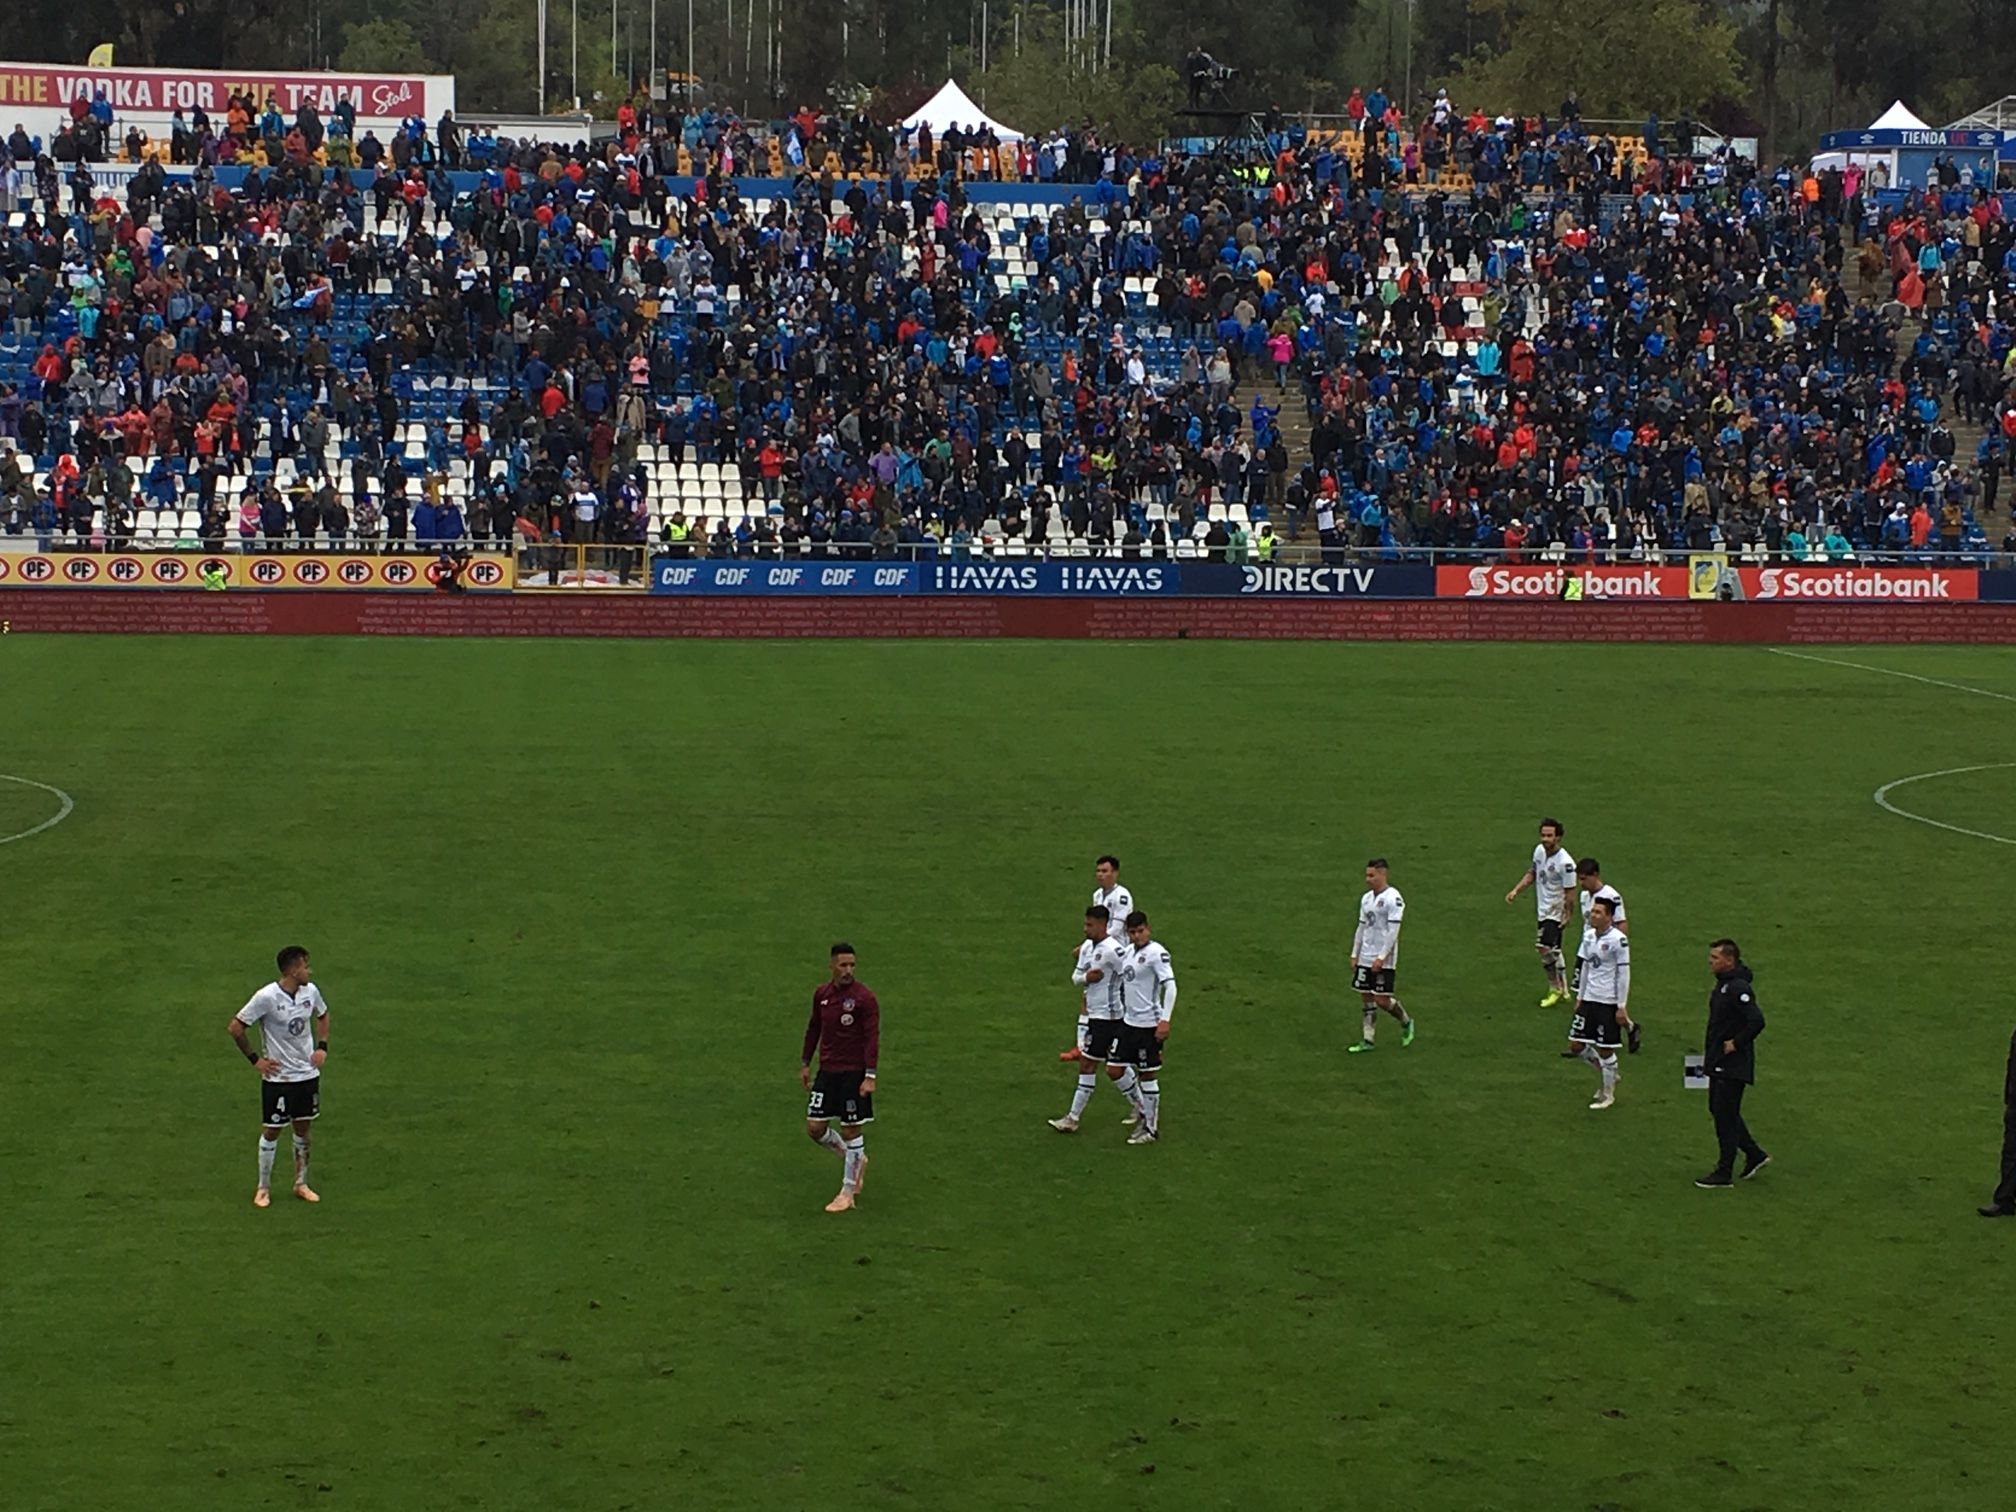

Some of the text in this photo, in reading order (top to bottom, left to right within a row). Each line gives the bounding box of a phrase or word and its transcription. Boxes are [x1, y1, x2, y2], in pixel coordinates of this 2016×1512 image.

[0, 75, 47, 103] THE
[56, 76, 153, 107] VODKA
[162, 80, 214, 109] FOR
[1901, 131, 1947, 145] TIENDA
[27, 561, 46, 577] PF
[71, 562, 91, 578] PF
[115, 562, 135, 578] PF
[160, 562, 179, 578] PF
[258, 563, 277, 580] PF
[302, 563, 321, 580] PF
[345, 564, 365, 580] PF
[389, 564, 408, 580] PF
[476, 565, 494, 581] PF
[662, 567, 696, 585] CDF
[715, 567, 749, 586] CDF
[768, 568, 802, 586] CDF
[821, 568, 855, 586] CDF
[874, 568, 908, 586] CDF
[936, 566, 1037, 589] HAVAS
[1062, 567, 1162, 590] HAVAS
[1241, 566, 1374, 593] DIRECTV
[1493, 568, 1661, 595] Scotibank
[1784, 571, 1949, 597] Scotiabank
[1572, 1014, 1585, 1030] 23
[276, 1096, 286, 1112] 4
[809, 1091, 824, 1108] 33
